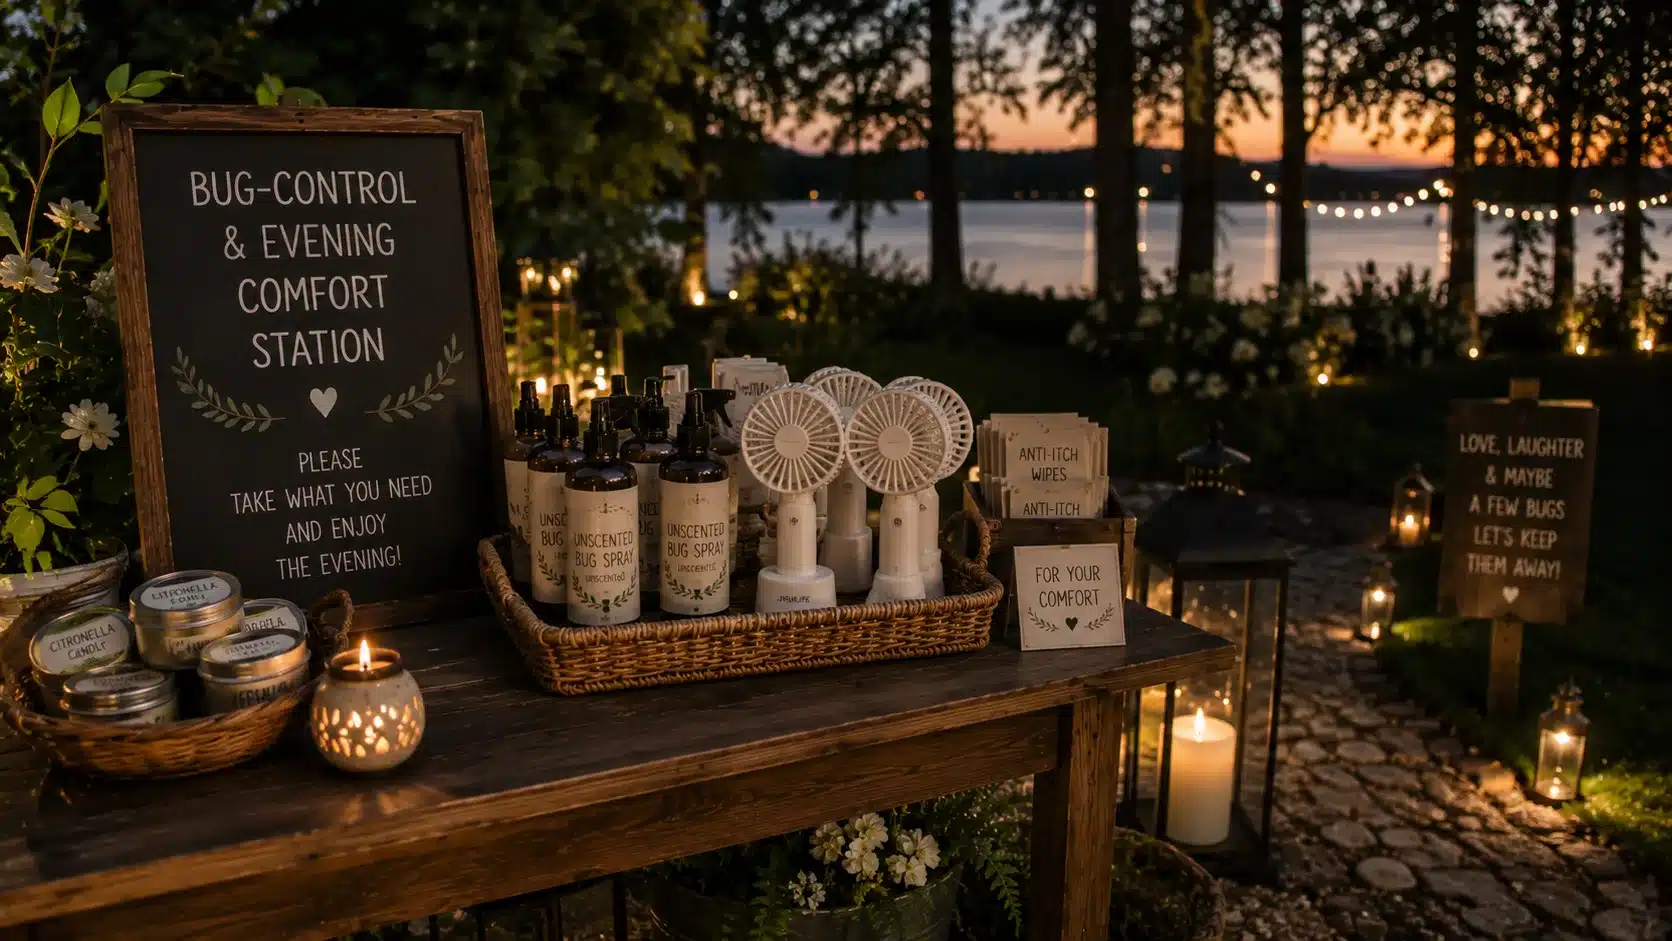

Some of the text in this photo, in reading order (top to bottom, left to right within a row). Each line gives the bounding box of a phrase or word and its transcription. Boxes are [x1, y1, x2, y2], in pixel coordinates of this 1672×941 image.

[190, 170, 417, 207] BUG-CONTROL
[223, 222, 396, 261] & EVENING
[237, 274, 389, 314] COMFORT
[251, 327, 386, 369] STATION
[1018, 446, 1079, 462] ANTI-ITCH
[1459, 432, 1585, 459] LOVE, LAUGHTER
[298, 447, 363, 473] PLEASE
[1031, 467, 1067, 482] WIPES
[1485, 464, 1555, 489] & MAYBE
[230, 474, 433, 515] TAKE WHAT YOU NEED
[1468, 493, 1567, 520] A FEW BUGS
[1022, 501, 1080, 517] ANTI-ITCH
[285, 513, 389, 545] AND ENJOY
[541, 530, 564, 547] BUG
[574, 530, 633, 548] UNSCENTED
[667, 521, 725, 539] UNSCENTED
[1473, 525, 1558, 550] LET'S KEEP
[575, 550, 597, 568] BUG
[603, 548, 635, 568] SPRAY
[667, 539, 725, 559] BUG SPRAY
[275, 545, 403, 581] THE EVENING!
[1035, 565, 1101, 584] FOR YOUR
[1466, 552, 1563, 581] THEM AWAY!
[1038, 588, 1100, 608] COMFORT
[49, 623, 116, 653] CITRONELLA
